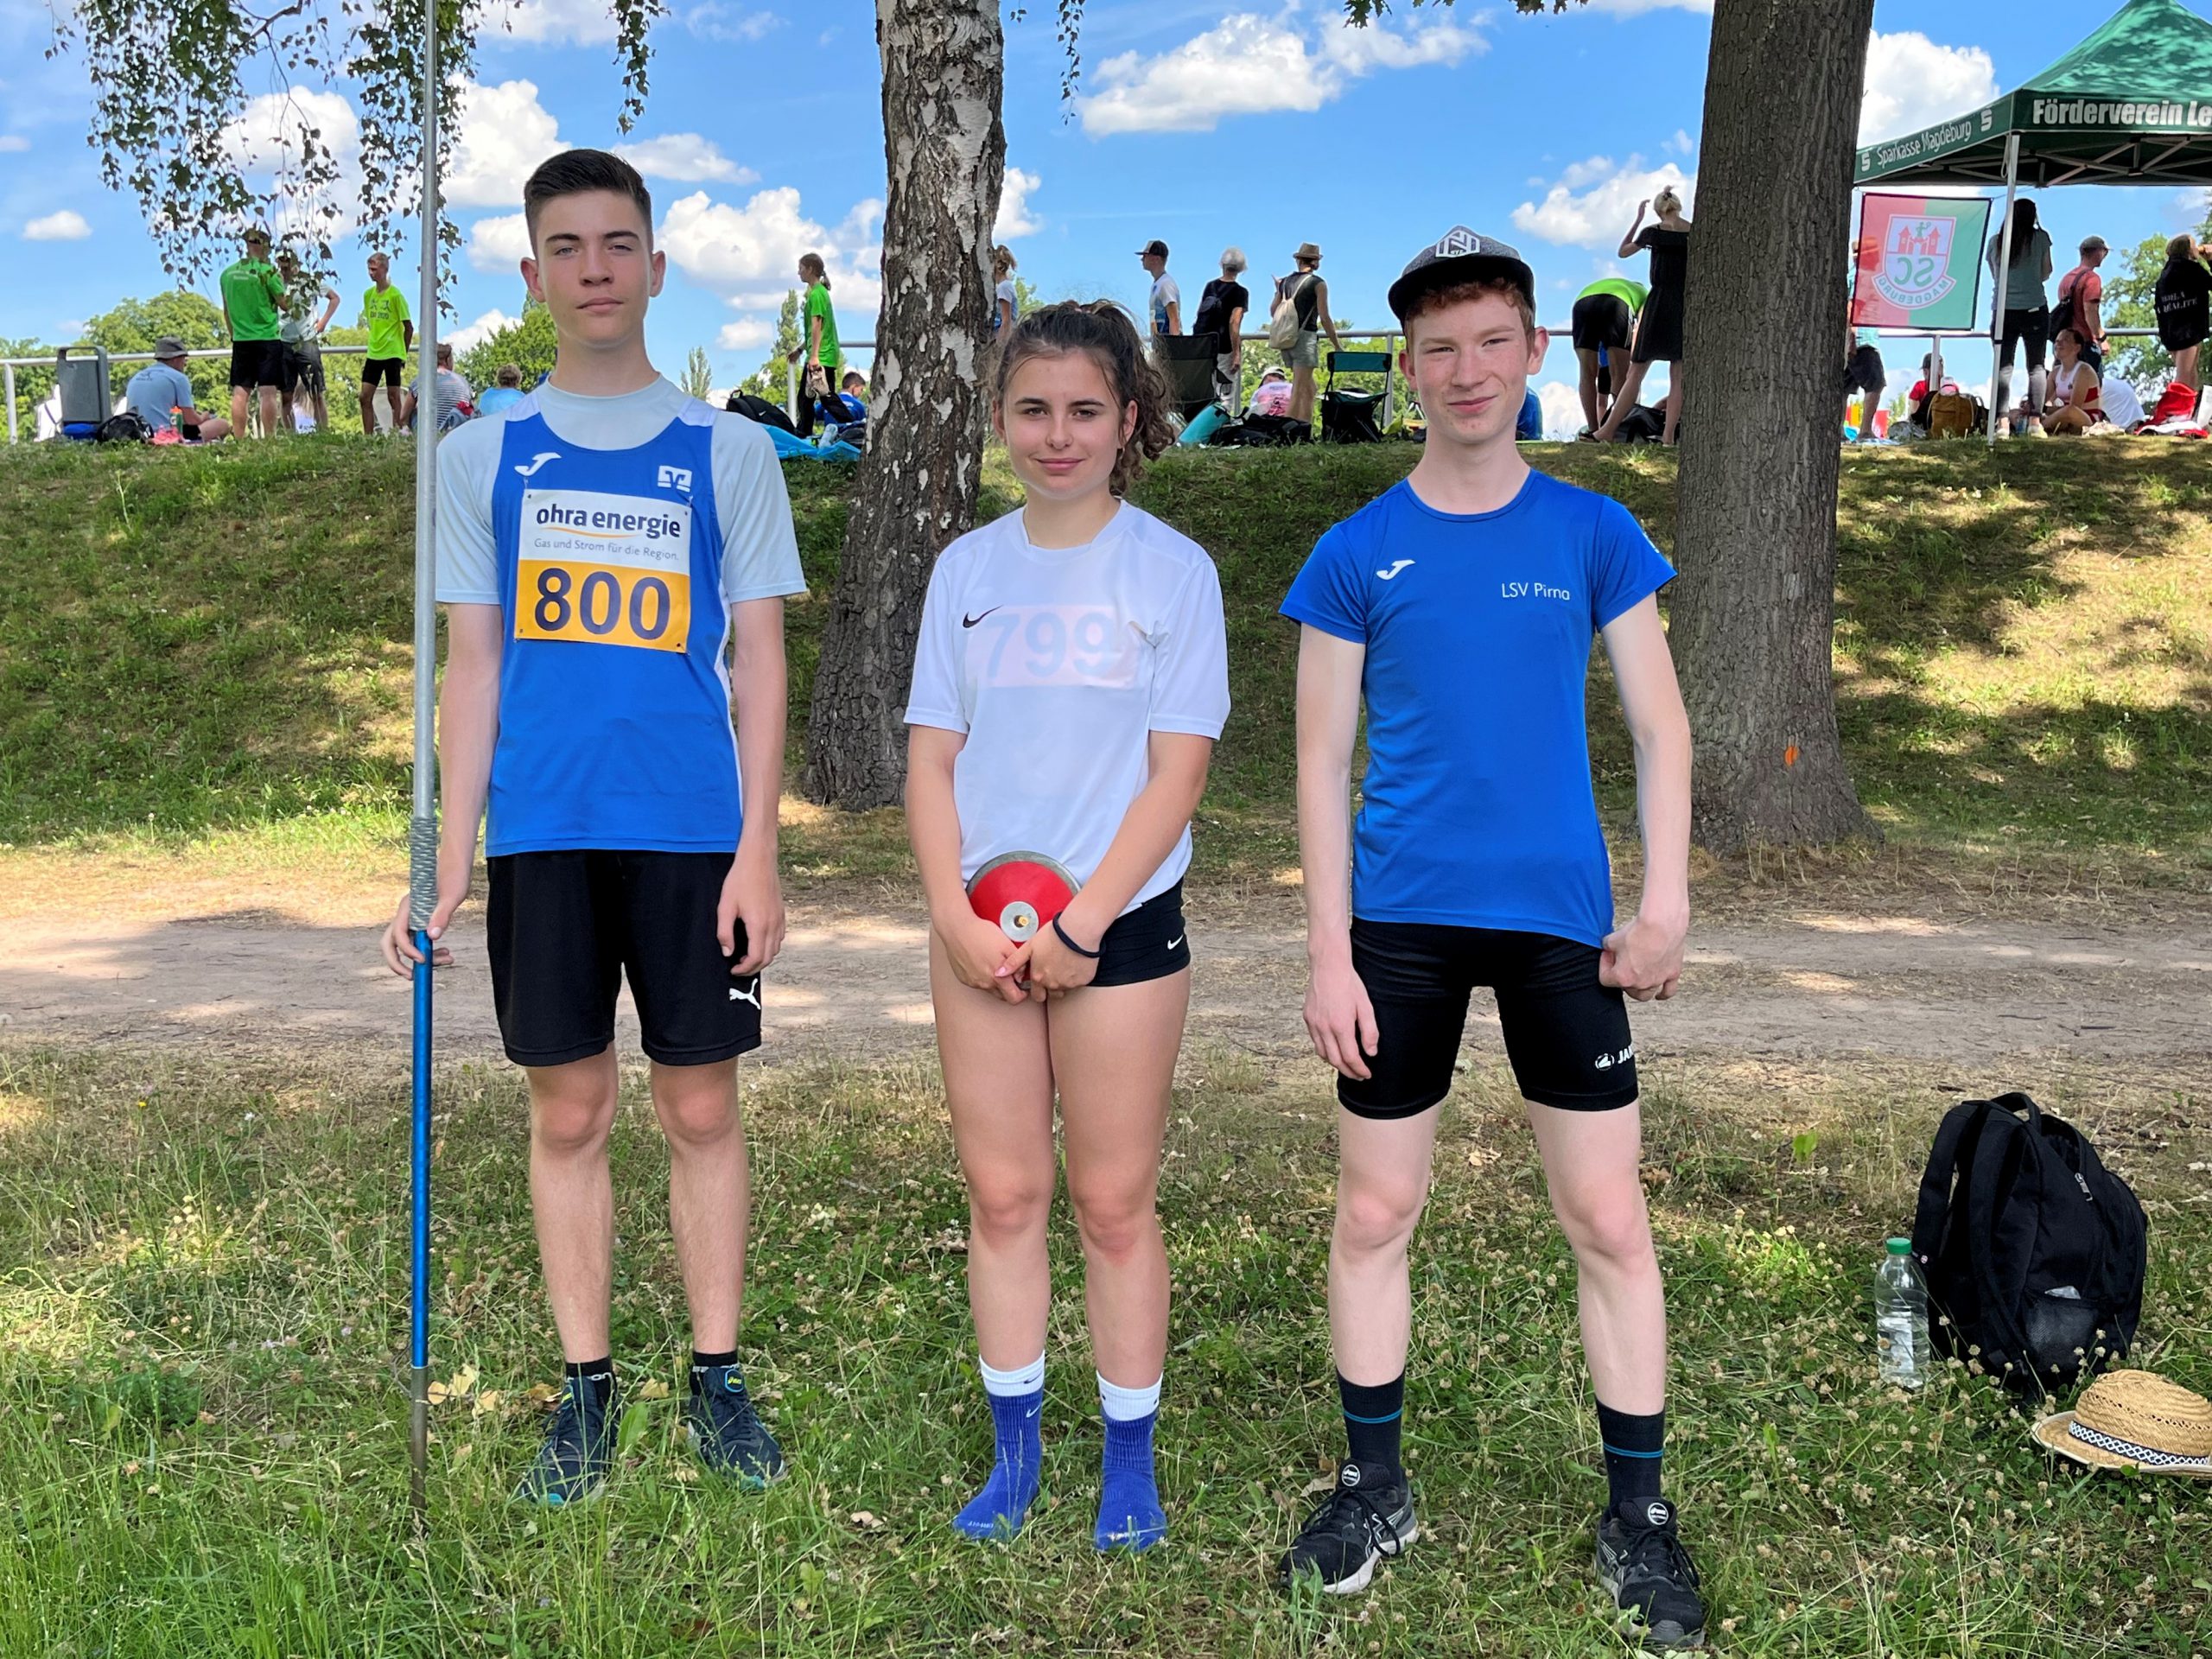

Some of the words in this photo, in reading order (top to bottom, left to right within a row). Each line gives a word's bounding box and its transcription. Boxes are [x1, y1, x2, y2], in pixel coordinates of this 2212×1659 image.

[2032, 98, 2183, 125] Förderverein
[1877, 138, 1921, 169] Sparkasse
[1922, 120, 1972, 152] Magdeburg
[537, 503, 588, 527] ohra
[592, 511, 681, 539] energie
[534, 537, 551, 549] Gas
[553, 538, 572, 550] und
[575, 539, 605, 552] Strom
[607, 542, 622, 554] für
[625, 543, 640, 556] die
[643, 547, 679, 561] Region.
[534, 566, 671, 640] 800
[1502, 582, 1529, 599] LSV
[1534, 582, 1571, 601] Pirna
[983, 611, 1116, 678] 799
